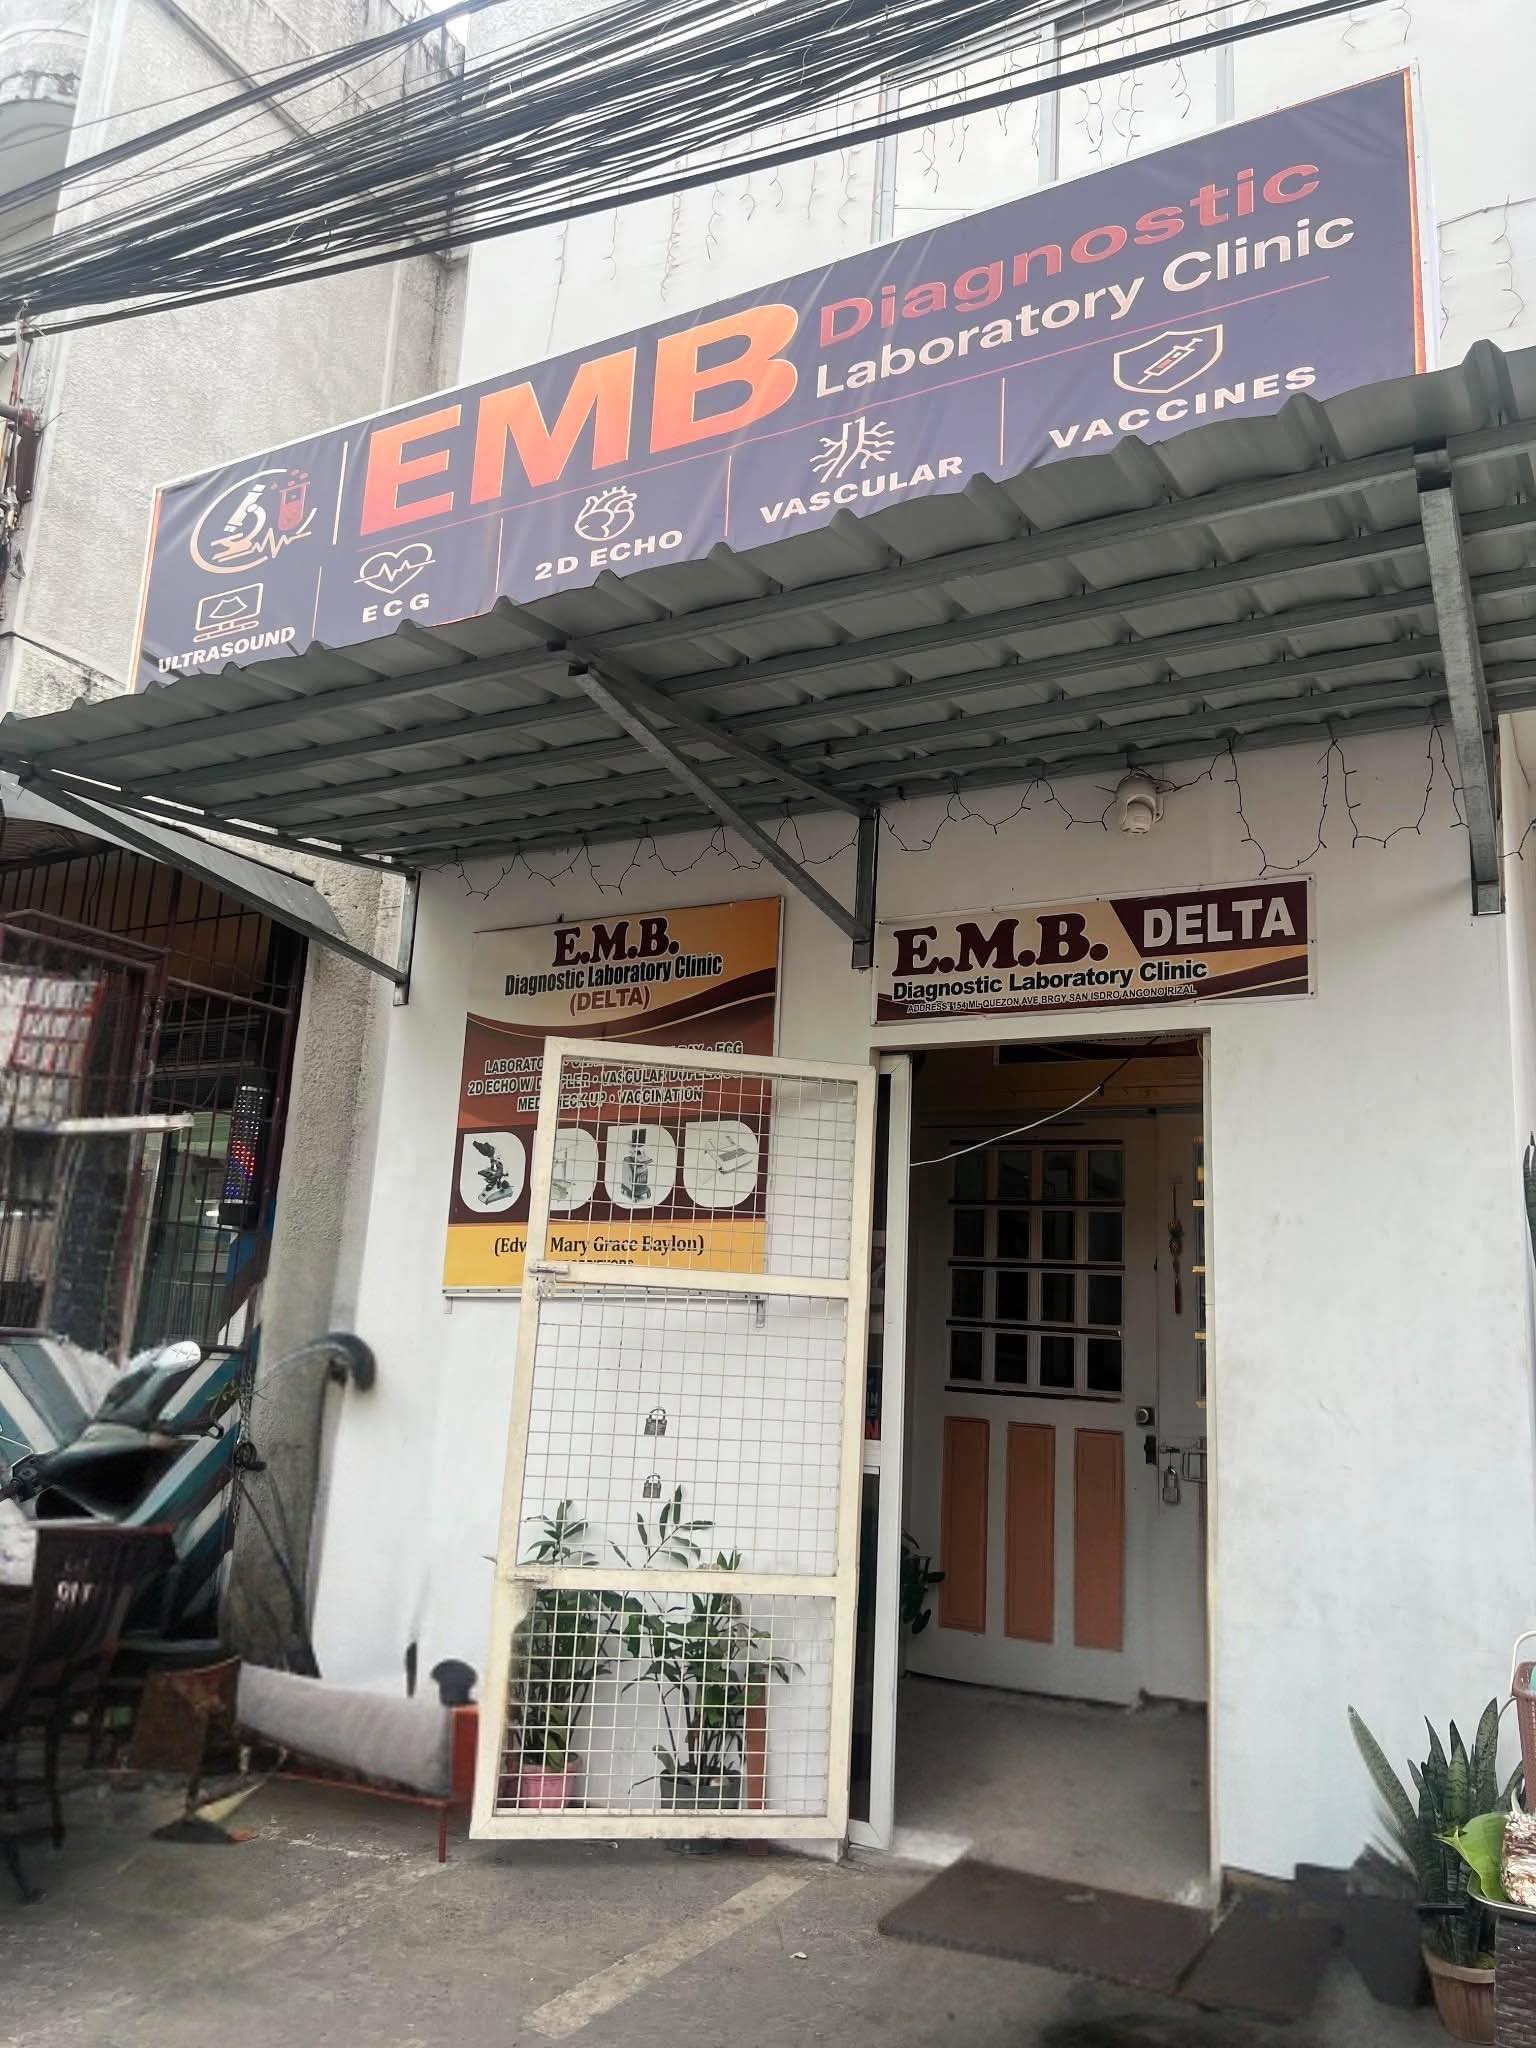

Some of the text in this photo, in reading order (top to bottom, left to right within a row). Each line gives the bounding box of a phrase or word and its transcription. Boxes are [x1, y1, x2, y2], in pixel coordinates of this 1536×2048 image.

[819, 164, 1320, 347] Diagnostic
[816, 217, 1355, 399] Laboratory Clinic
[360, 303, 799, 537] EMB
[1048, 366, 1317, 449] VACCINES
[760, 455, 963, 523] VASCULAR
[535, 530, 683, 580] 2D ECHO
[362, 592, 431, 623] ECG
[158, 626, 296, 673] ULTRASOUND
[552, 917, 680, 967] E.M.B.
[892, 912, 1109, 977] E.M.B.
[1143, 897, 1296, 948] DELTA
[505, 954, 723, 996] Diagnostic Laboratory Clinic
[893, 959, 1207, 1002] Diagnostic Laboratory Clinic
[1041, 993, 1066, 1004] BRGY
[1069, 992, 1088, 1002] SAN
[570, 986, 651, 1016] (DELTA)
[468, 1079, 483, 1095] 2D
[486, 1078, 517, 1093] ECHO
[485, 1057, 544, 1075] LABORATO
[620, 1087, 704, 1104] VACCINATION
[550, 1237, 587, 1256] Mary
[594, 1236, 638, 1252] Grace
